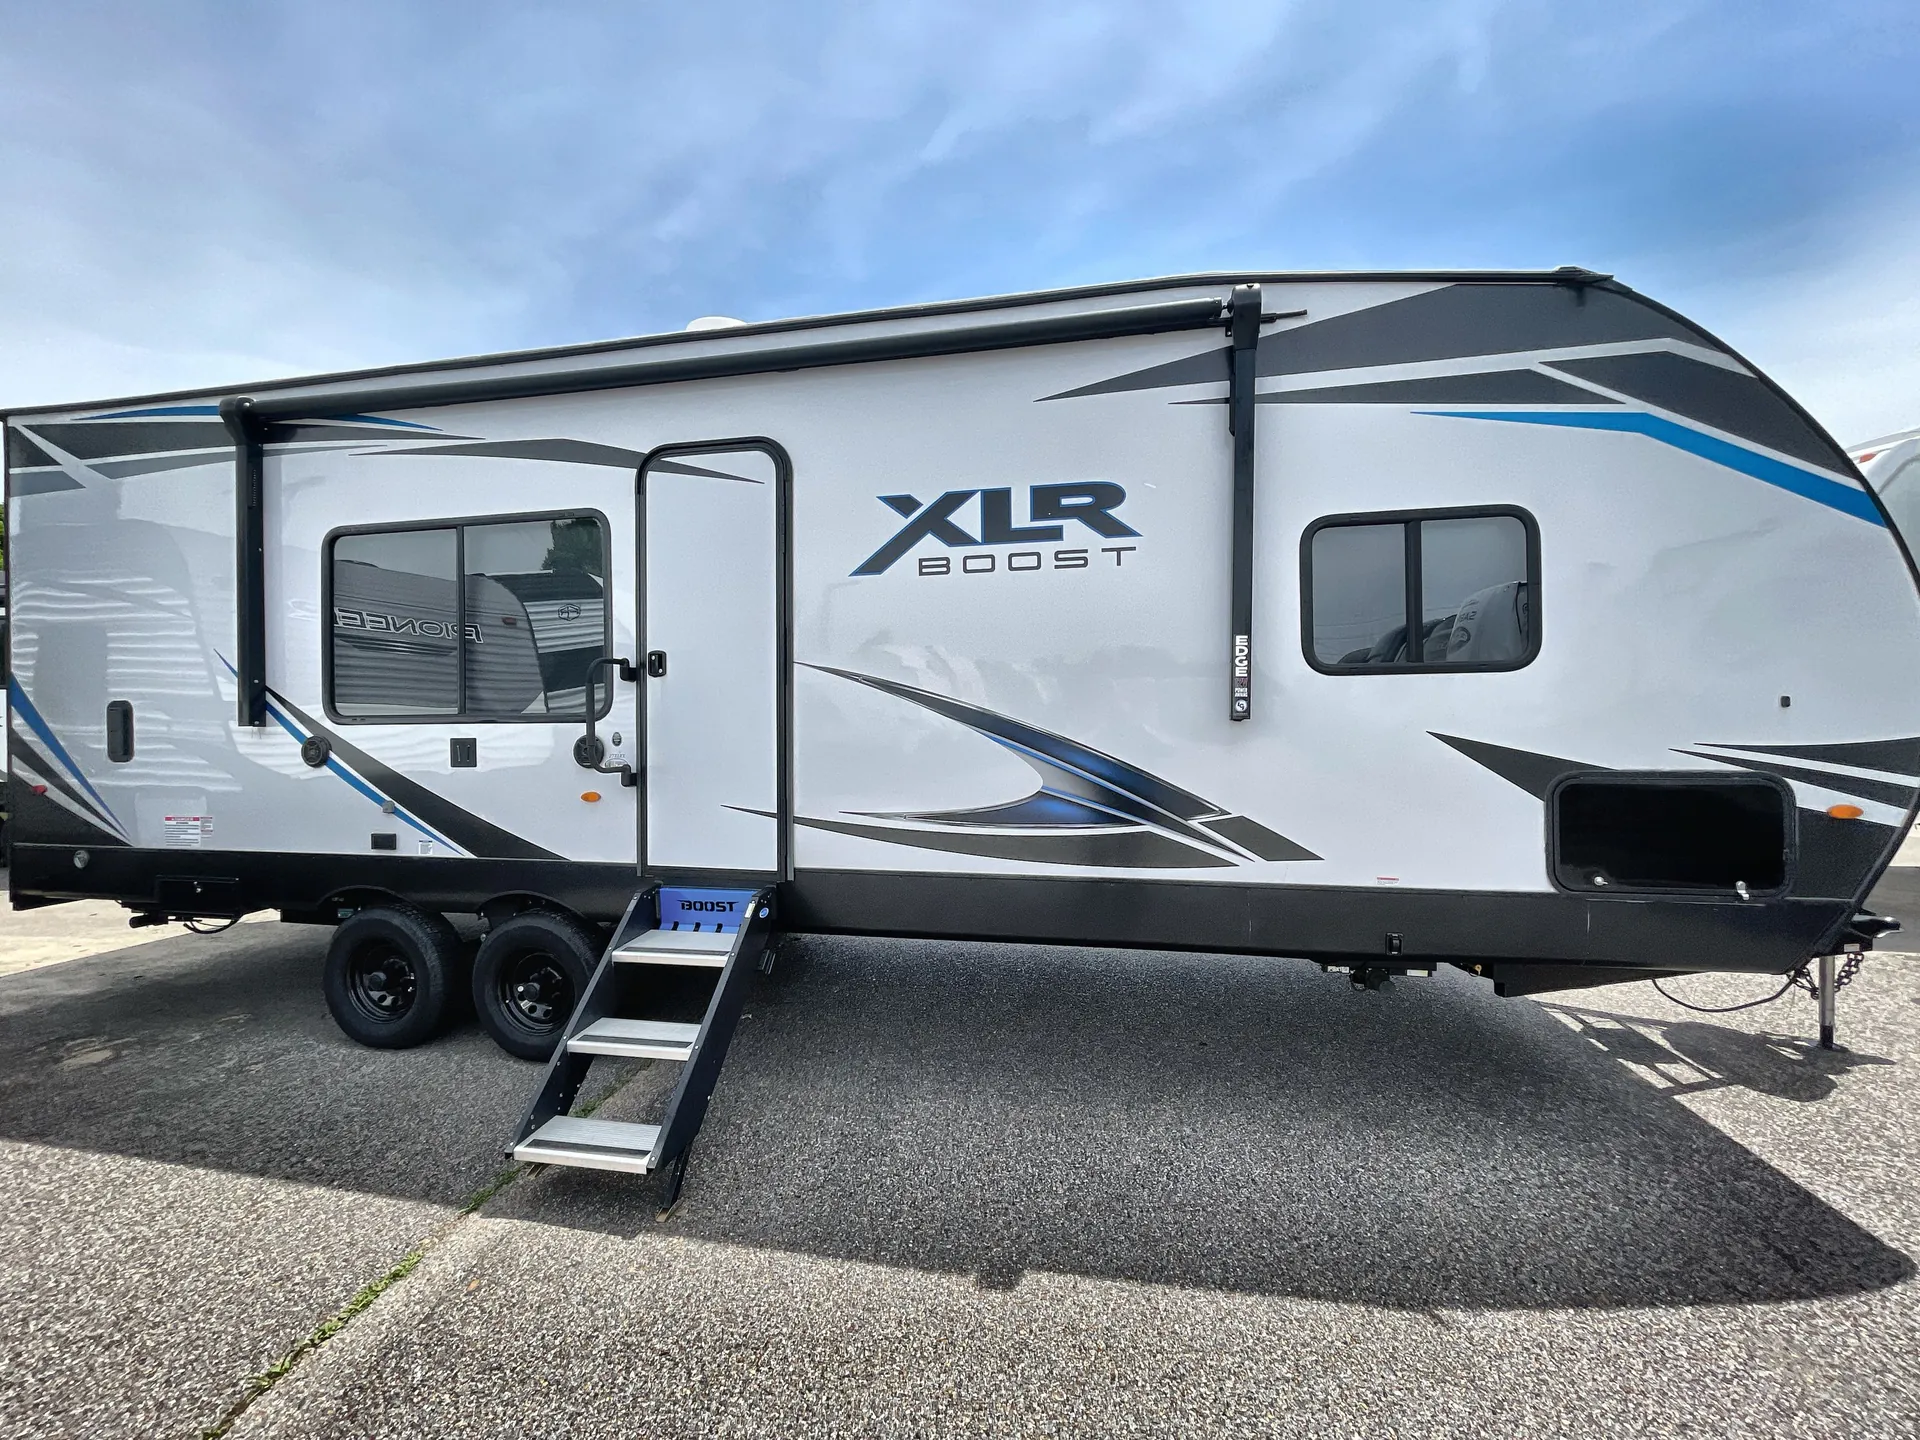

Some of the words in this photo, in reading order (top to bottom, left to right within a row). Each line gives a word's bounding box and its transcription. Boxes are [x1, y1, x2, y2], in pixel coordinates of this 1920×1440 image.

[848, 481, 1143, 577] XLR
[918, 546, 1137, 577] BOOST
[1234, 635, 1249, 677] EDGE
[677, 900, 739, 912] BOOST
